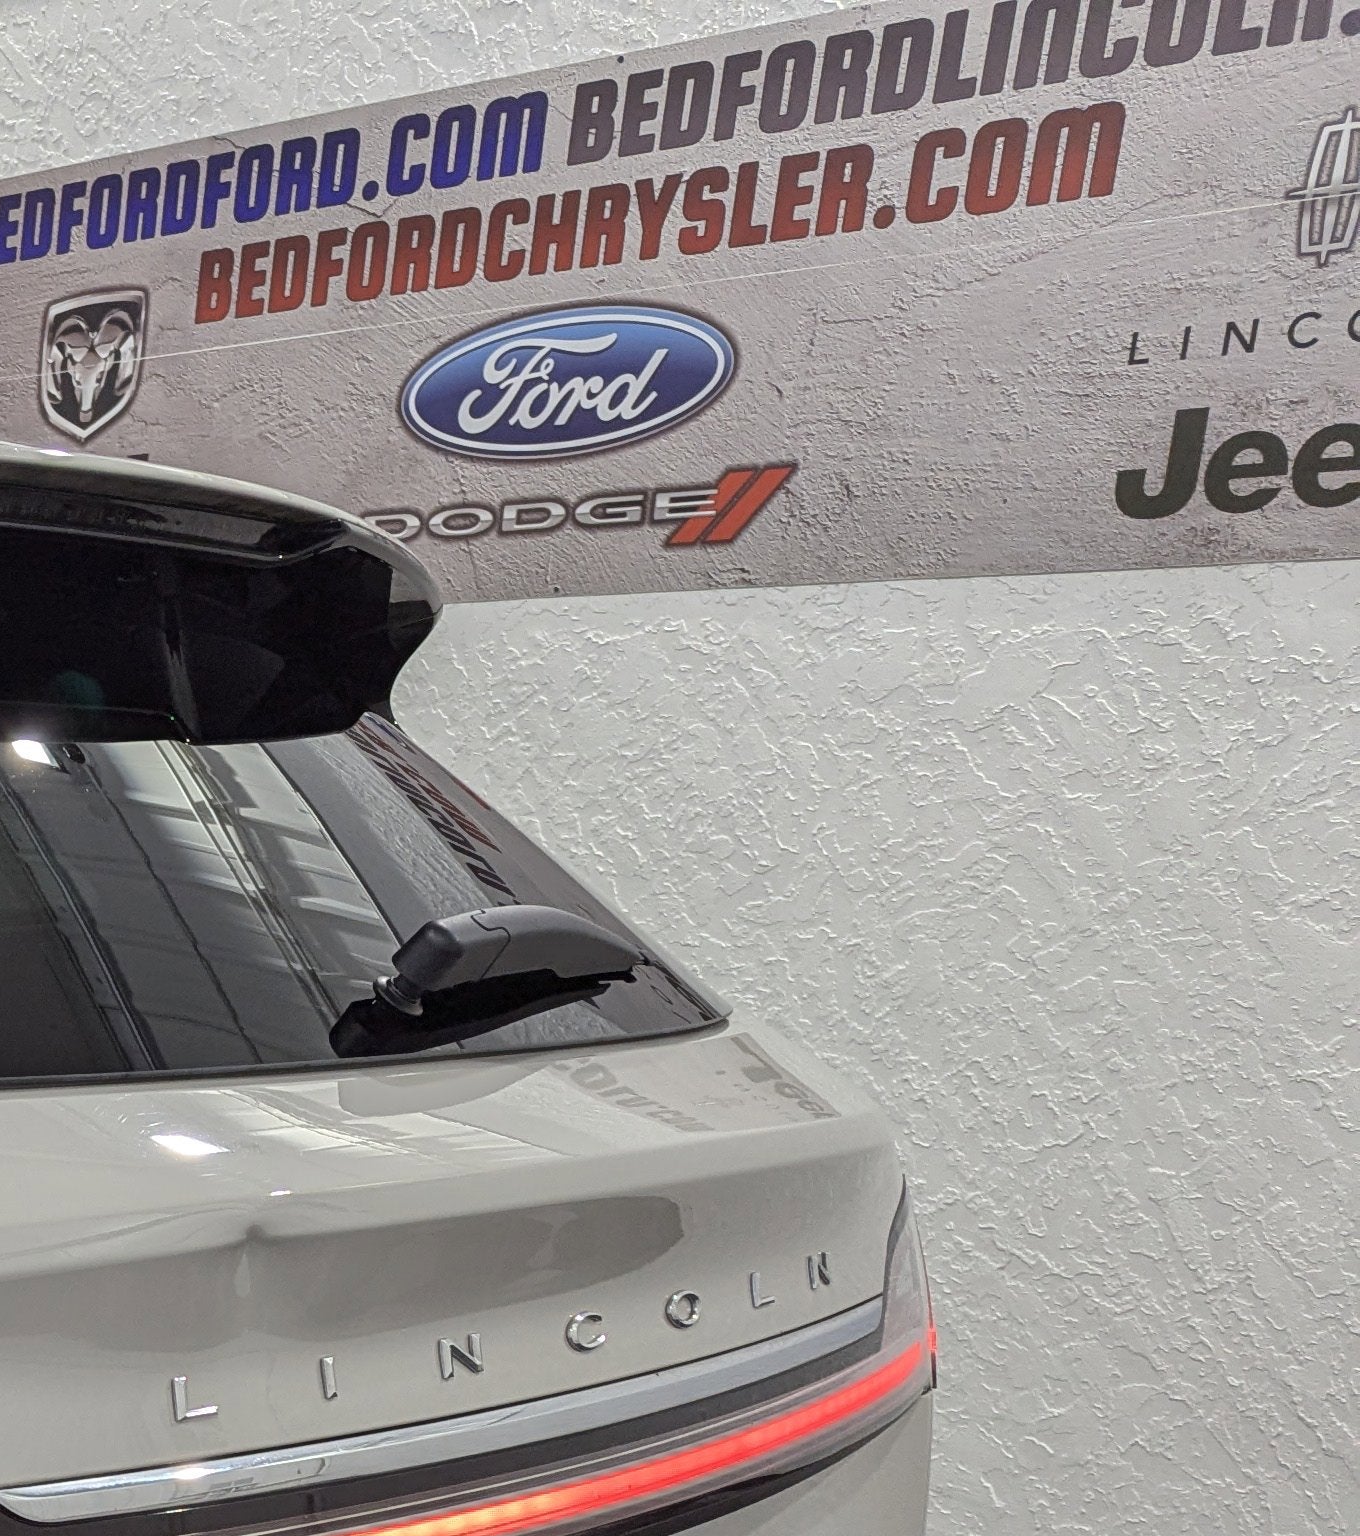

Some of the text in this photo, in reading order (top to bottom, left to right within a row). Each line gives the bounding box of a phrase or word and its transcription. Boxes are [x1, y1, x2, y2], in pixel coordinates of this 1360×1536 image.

[194, 101, 1127, 324] BEDFORDCHRYSLER.COM
[457, 332, 669, 434] Ford
[367, 487, 720, 541] DODGE
[1115, 407, 1360, 520] Jee
[171, 1252, 831, 1423] LINCOLN
